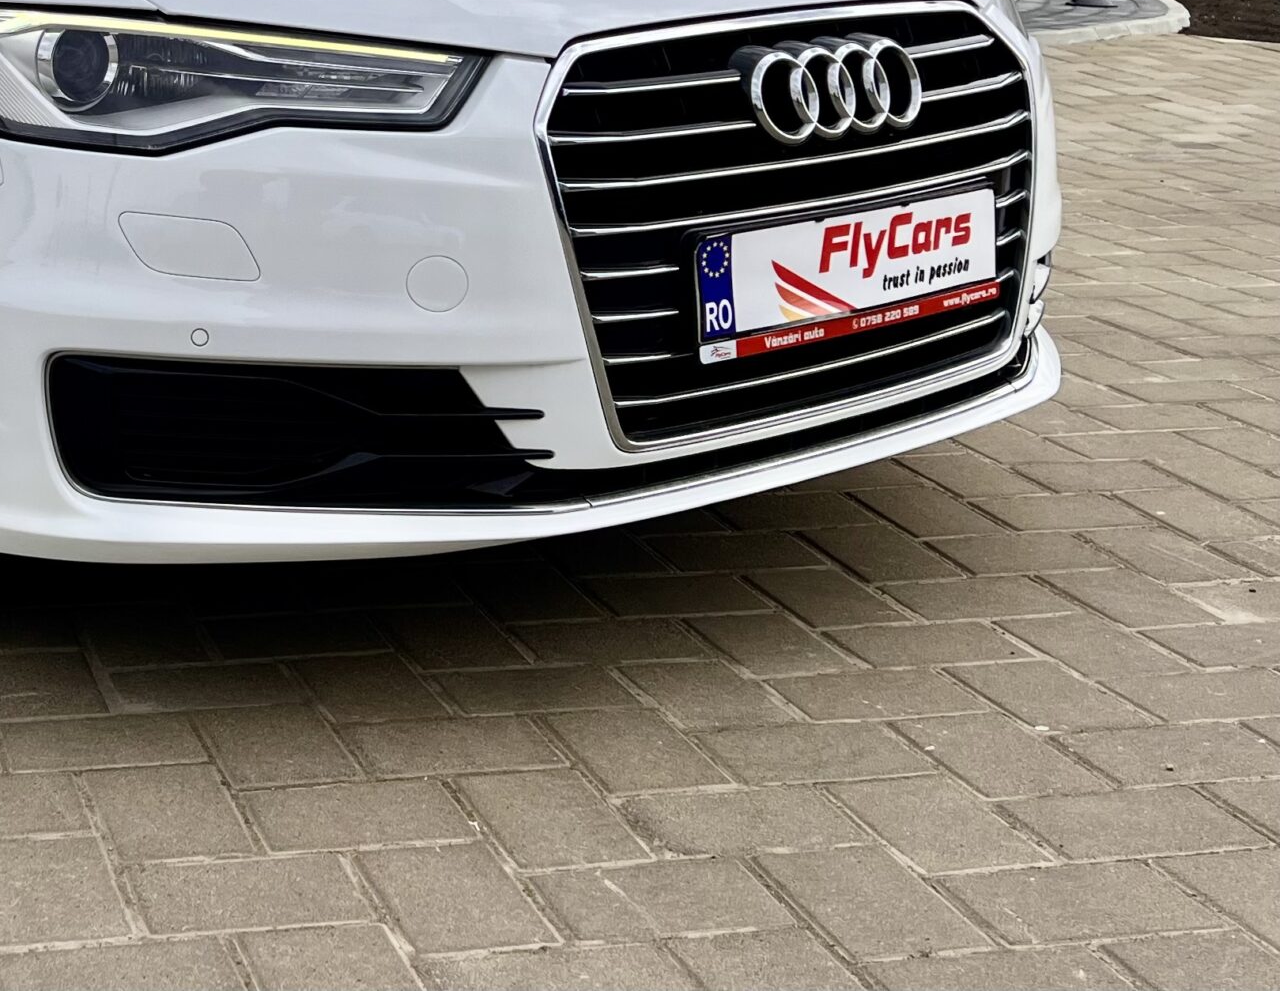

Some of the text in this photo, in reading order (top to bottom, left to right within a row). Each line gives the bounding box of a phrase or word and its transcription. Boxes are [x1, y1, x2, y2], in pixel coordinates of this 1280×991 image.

[819, 212, 972, 279] FlyCars
[883, 257, 970, 291] trust in passion
[705, 299, 732, 333] RO
[884, 309, 902, 322] 220
[803, 326, 825, 341] auto
